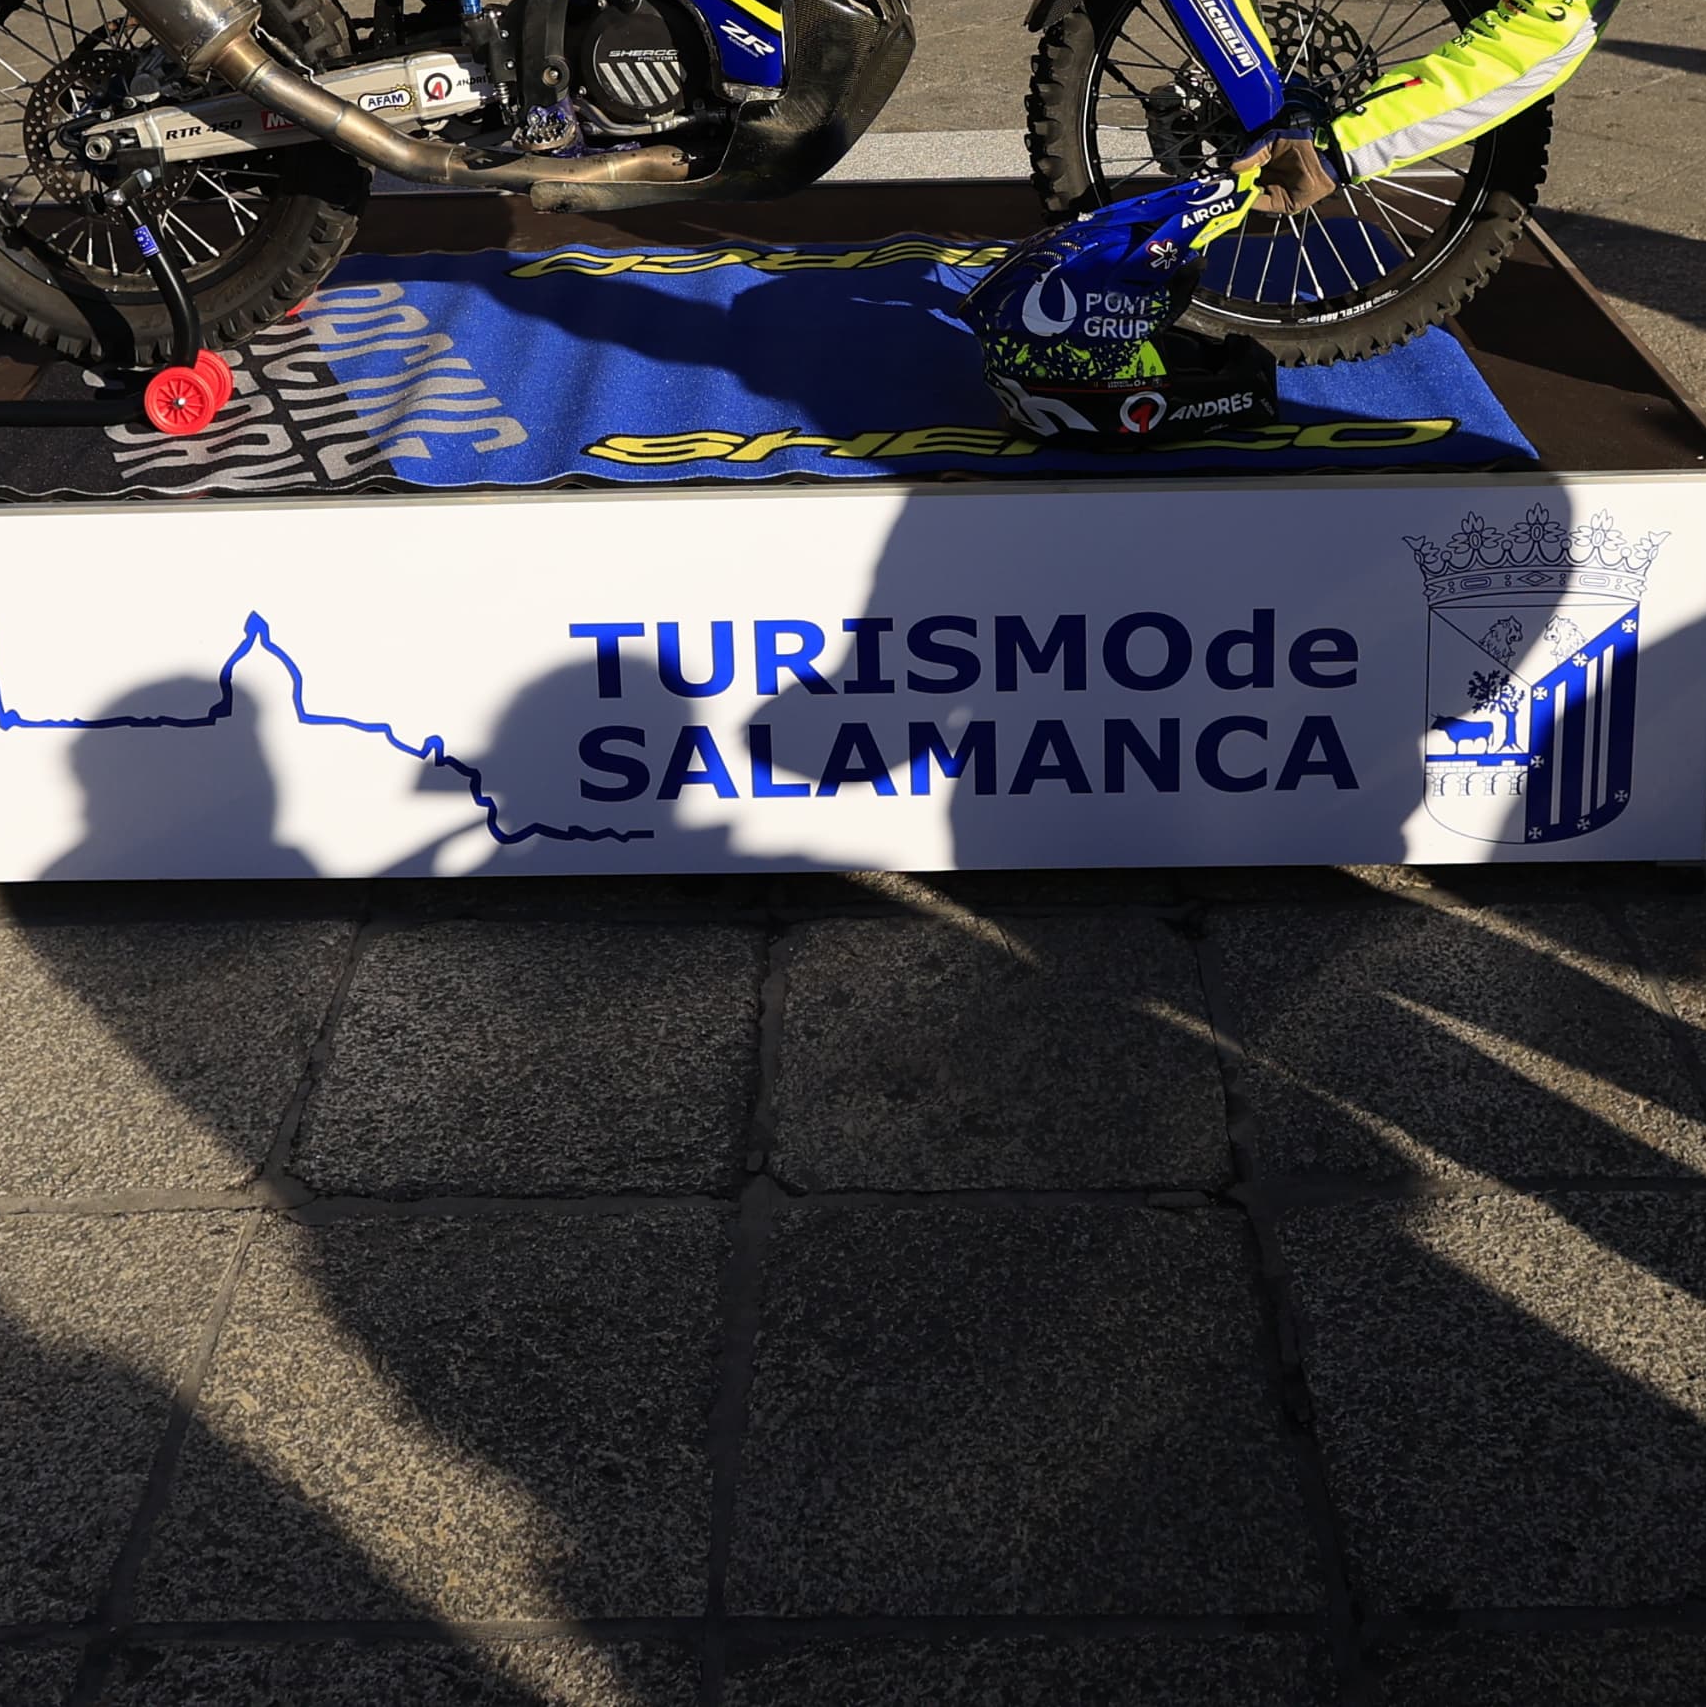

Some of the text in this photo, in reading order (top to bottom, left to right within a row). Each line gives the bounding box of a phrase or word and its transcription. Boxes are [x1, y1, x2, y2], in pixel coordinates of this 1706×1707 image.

[719, 19, 776, 56] ZR
[367, 93, 405, 108] AFAM
[165, 125, 204, 141] RTR
[207, 119, 244, 134] 450
[1181, 198, 1236, 230] AIROH
[1086, 293, 1149, 315] PONT
[1083, 317, 1150, 340] GRUP
[1169, 392, 1253, 421] ANDRÉS
[569, 607, 1360, 700] TURISMOde
[578, 716, 1360, 805] SALAMANCA
